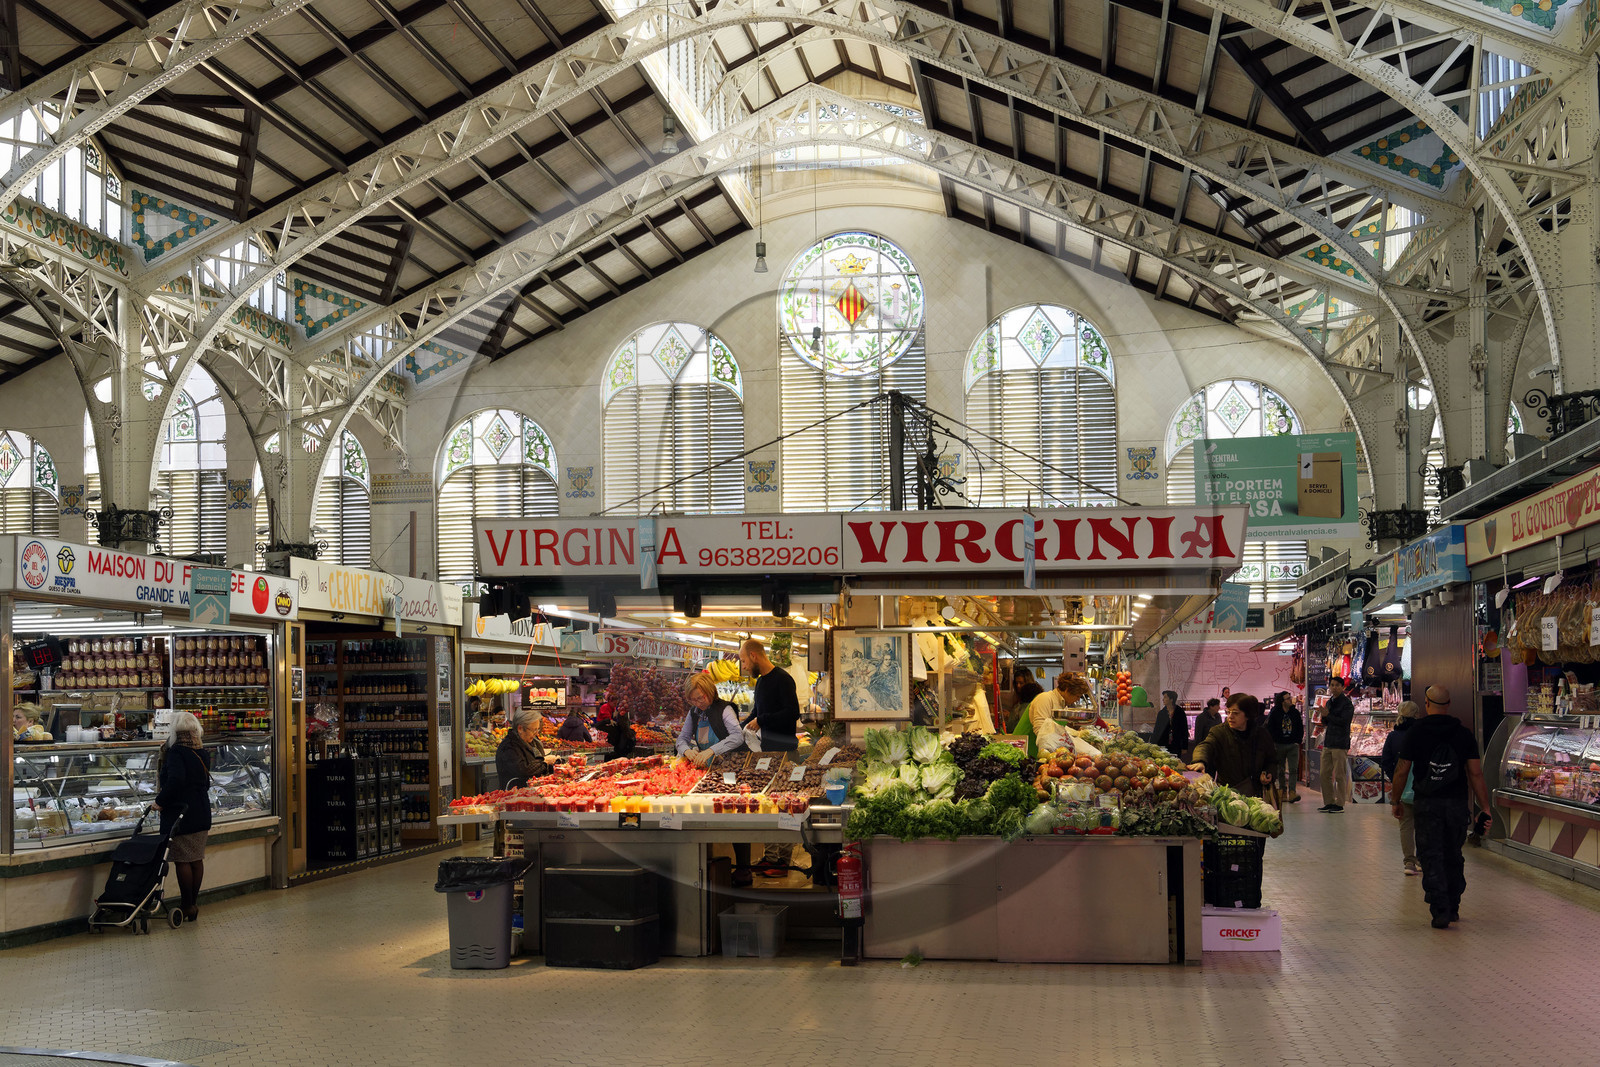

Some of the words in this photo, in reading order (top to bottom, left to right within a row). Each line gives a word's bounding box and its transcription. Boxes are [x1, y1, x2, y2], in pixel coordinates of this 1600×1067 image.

[1211, 453, 1239, 463] CENTRAL
[1204, 481, 1221, 492] ET
[1225, 478, 1283, 492] PORTEM
[1205, 492, 1226, 502] TOT
[1230, 491, 1242, 501] EL
[1245, 490, 1283, 500] SABOR
[1244, 527, 1338, 538] adocentralvalencia.es
[1511, 510, 1525, 542] EL
[484, 527, 689, 567] VIRGINA
[741, 520, 794, 540] TEL:
[847, 514, 1237, 564] VIRGINIA
[698, 546, 839, 567] 963829206
[88, 550, 146, 580] MAISON
[154, 560, 174, 584] DU
[25, 571, 44, 587] QUESO
[196, 581, 226, 591] domicili
[197, 573, 220, 583] Servei
[136, 585, 175, 603] GRANDE
[328, 569, 385, 615] CERVEZAS
[1219, 928, 1261, 938] CRICKET
